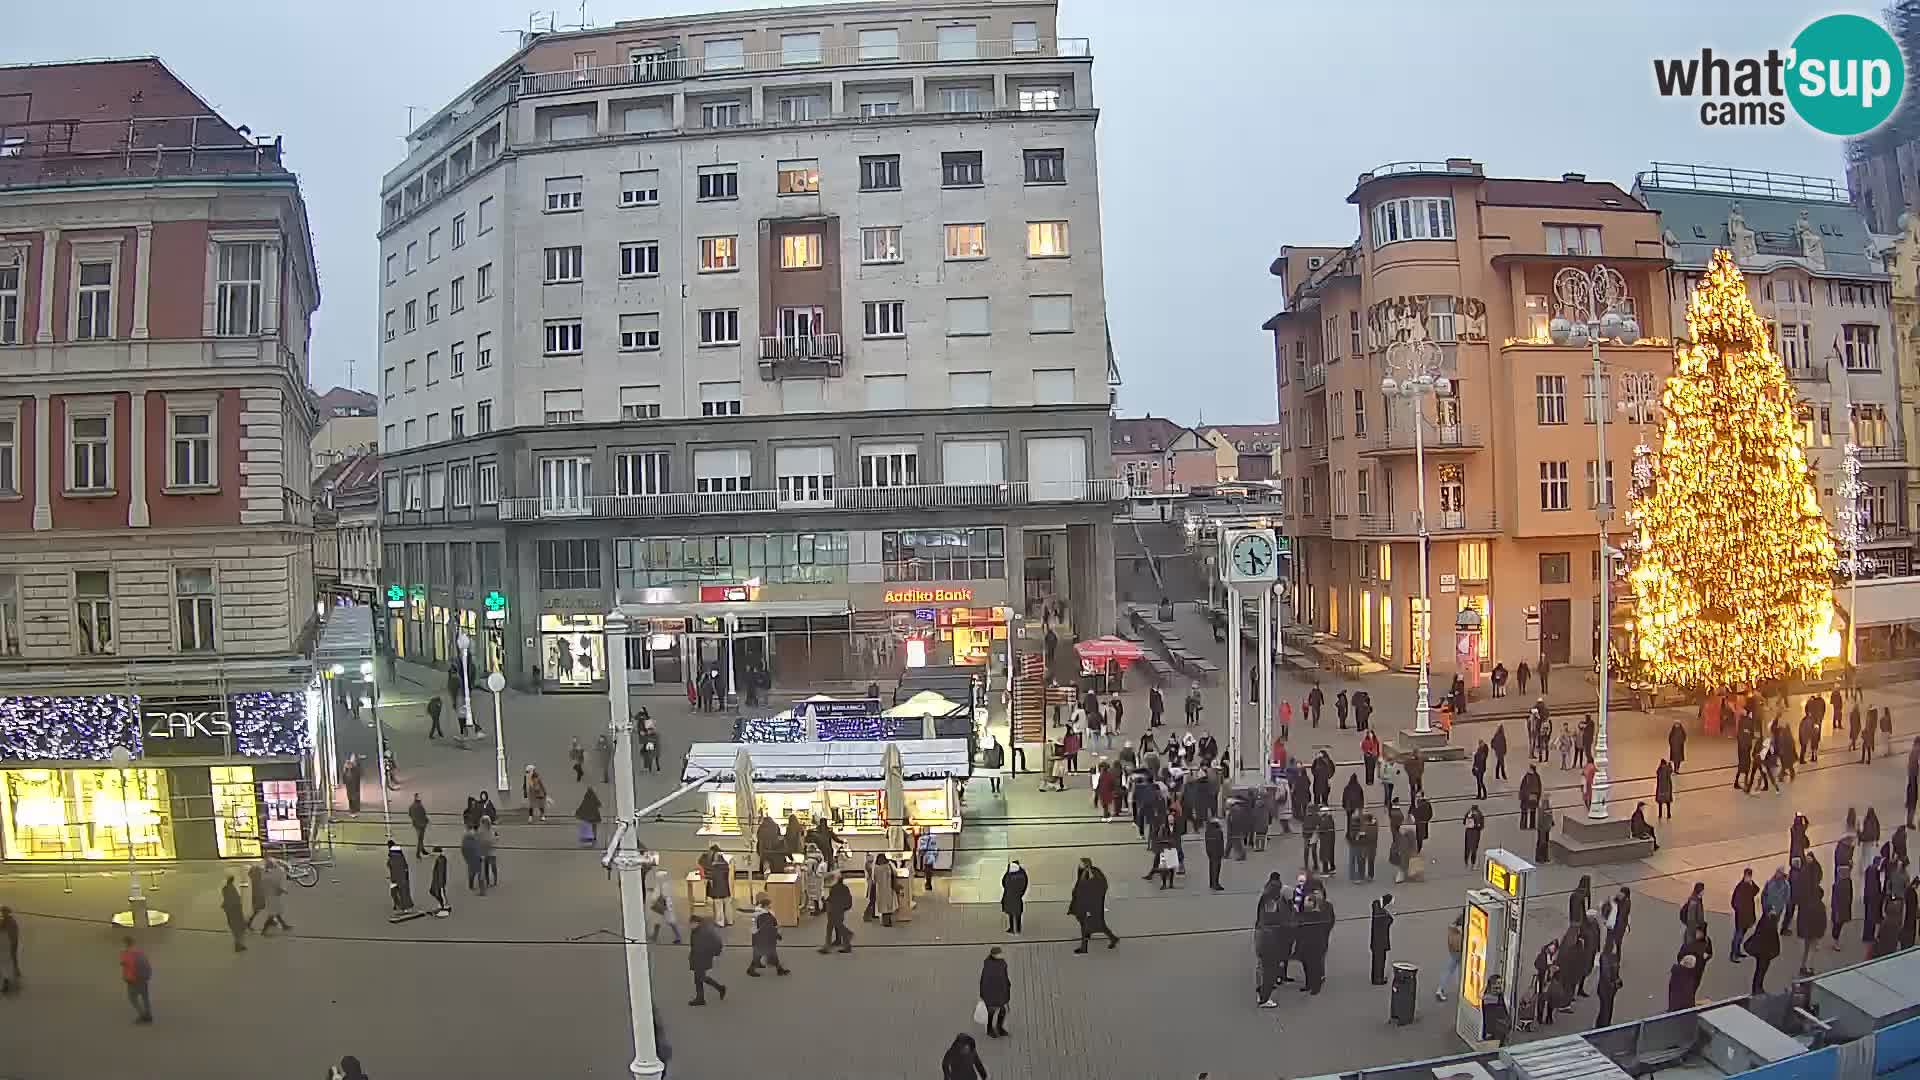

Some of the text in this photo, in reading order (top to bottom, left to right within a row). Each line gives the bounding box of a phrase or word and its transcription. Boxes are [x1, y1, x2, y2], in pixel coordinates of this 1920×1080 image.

[884, 588, 972, 603] Addiko Bank
[144, 711, 232, 737] ZAKS
